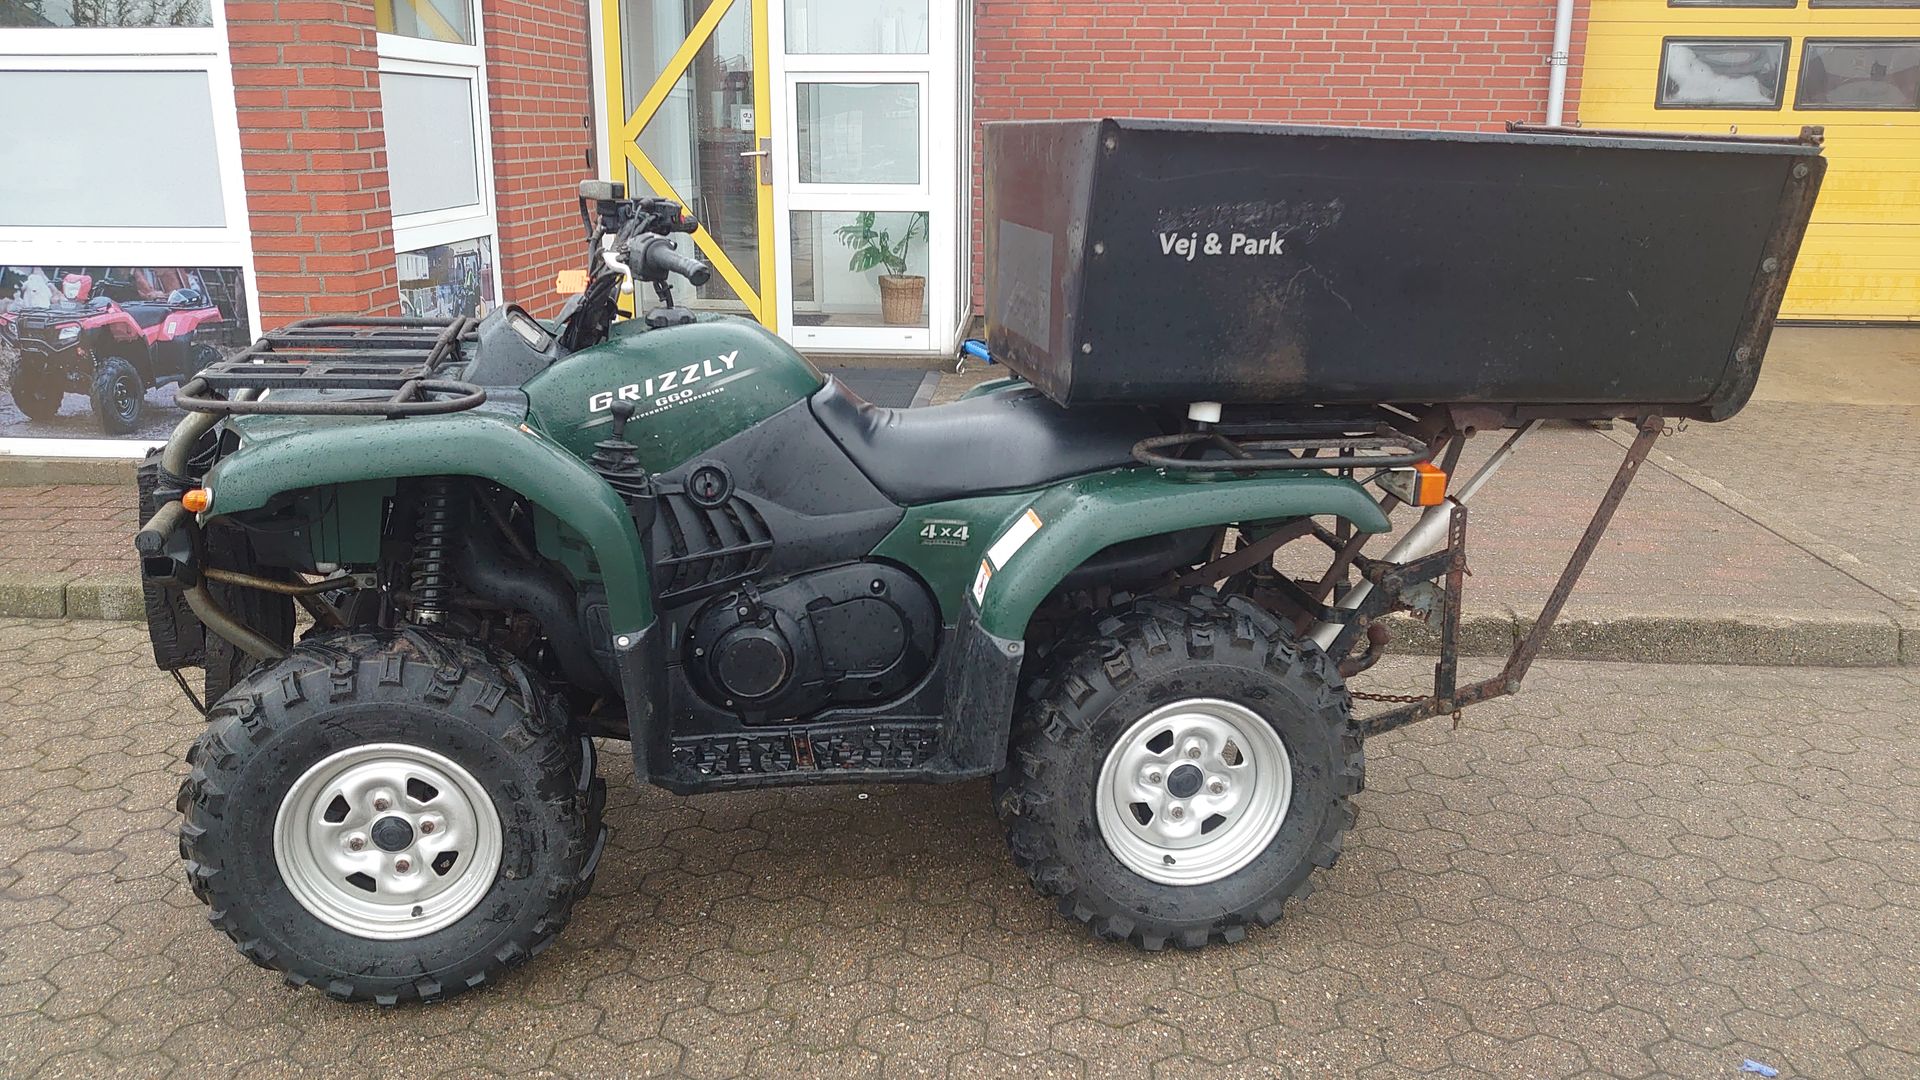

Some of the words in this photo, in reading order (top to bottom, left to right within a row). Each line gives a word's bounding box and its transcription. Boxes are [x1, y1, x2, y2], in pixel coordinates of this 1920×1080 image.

[1159, 232, 1197, 261] Vej
[1203, 232, 1223, 255] &
[1229, 231, 1285, 255] Park
[589, 350, 739, 413] GRIZZLY
[626, 404, 673, 423] NDEPENDENT
[920, 524, 970, 541] 4x4
